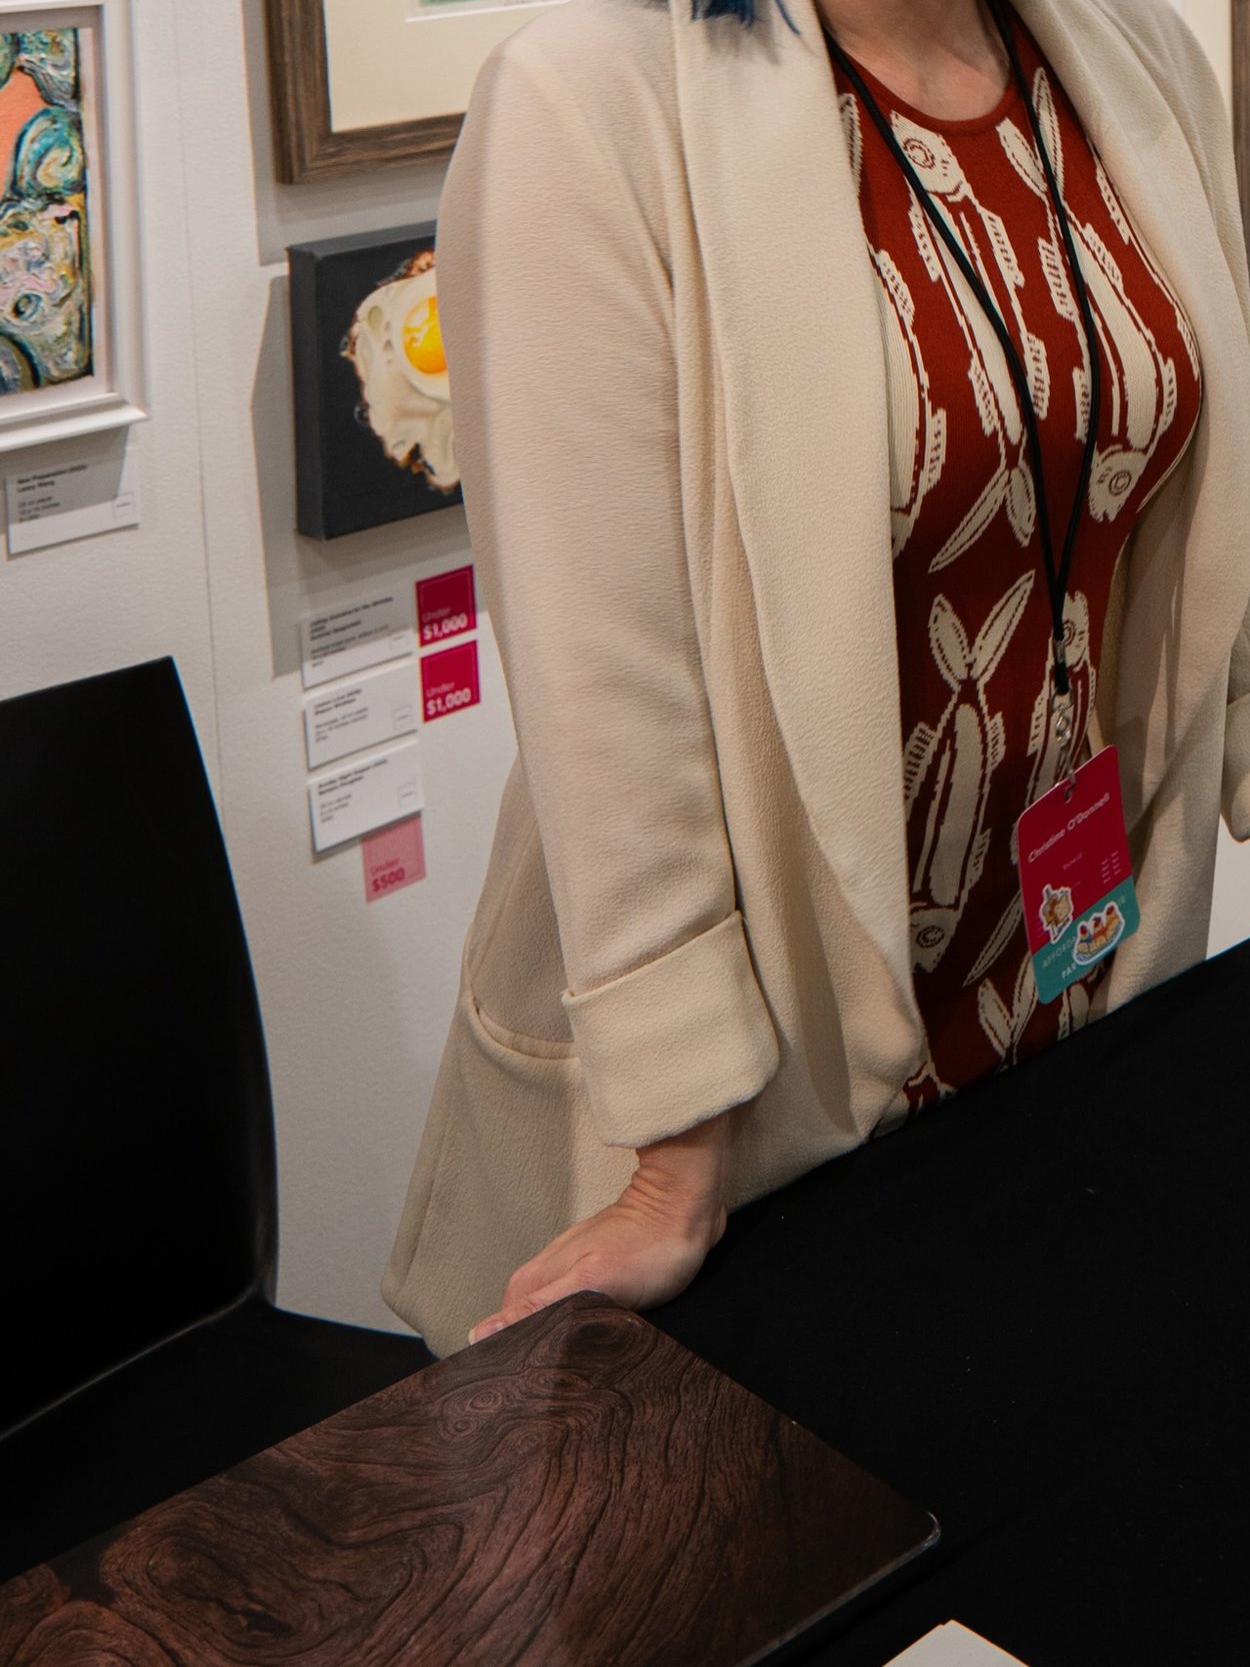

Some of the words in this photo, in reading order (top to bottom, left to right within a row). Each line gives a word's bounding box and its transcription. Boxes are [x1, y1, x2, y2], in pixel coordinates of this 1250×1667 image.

[422, 607, 451, 623] Under
[423, 613, 468, 640] $1,000
[426, 682, 455, 697] Under
[426, 688, 472, 715] $1,000
[1028, 829, 1066, 863] Christine
[1067, 792, 1110, 830] O'Donnell
[369, 859, 400, 876] Under
[372, 868, 406, 893] $500
